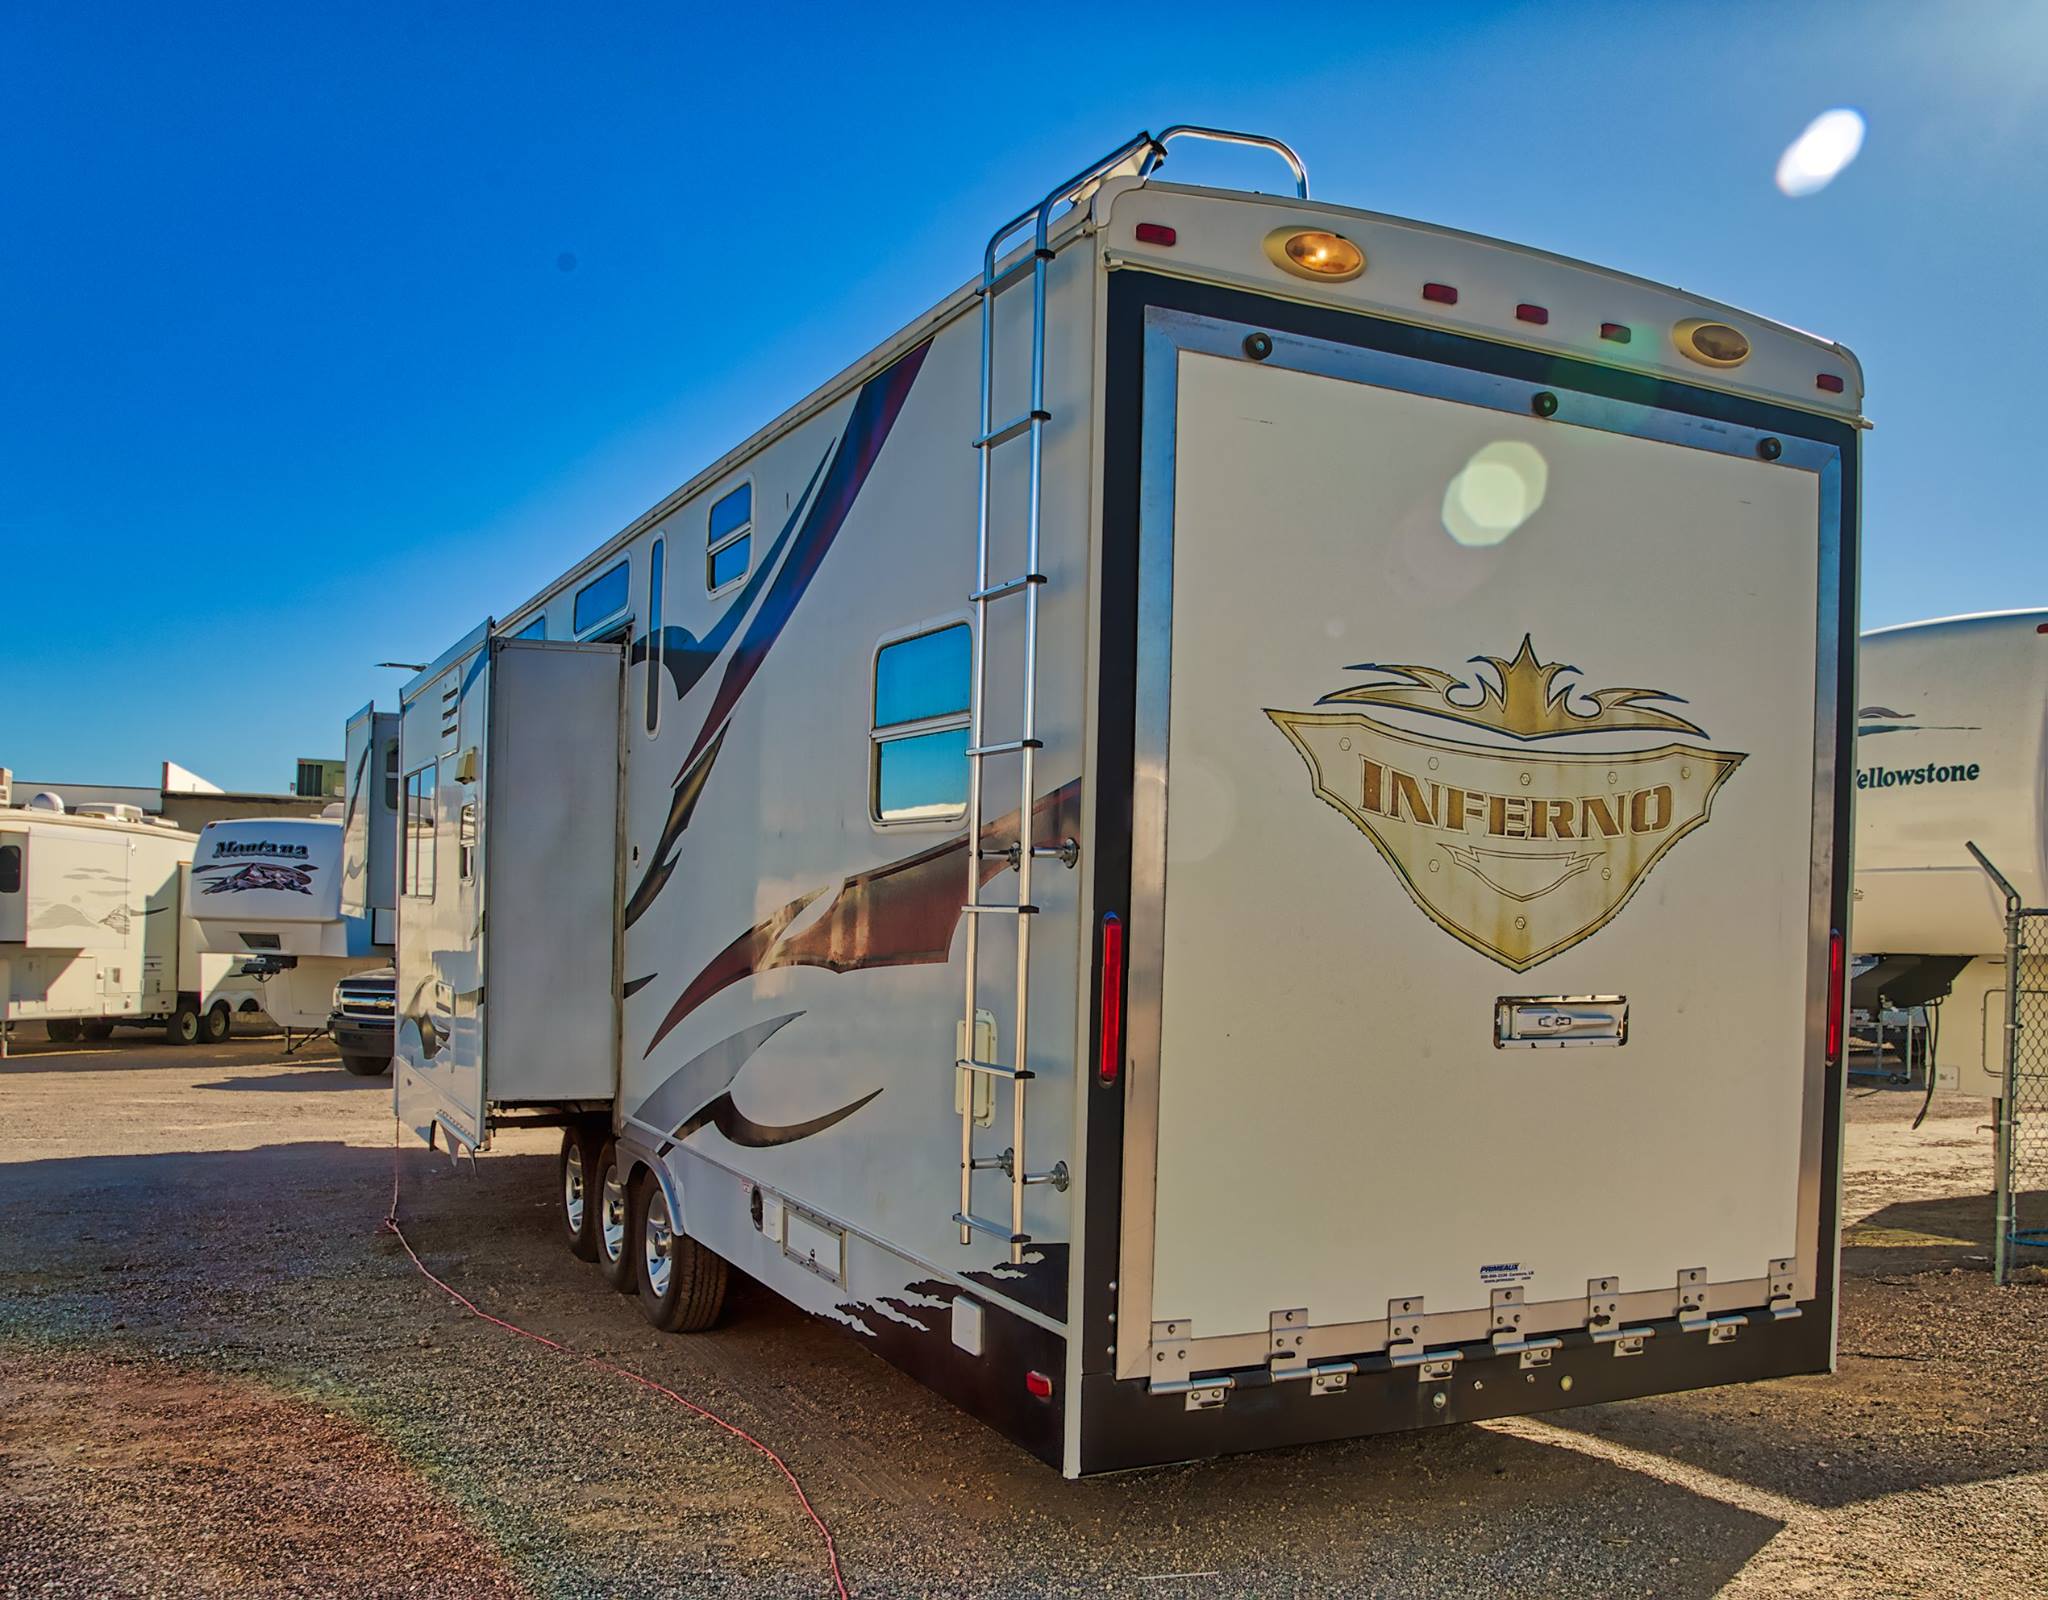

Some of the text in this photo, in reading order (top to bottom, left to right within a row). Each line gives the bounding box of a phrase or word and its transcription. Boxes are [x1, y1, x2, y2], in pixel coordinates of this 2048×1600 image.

[1856, 763, 1980, 789] ellowstone
[1359, 754, 1674, 841] INFERNO
[212, 840, 309, 859] Montana
